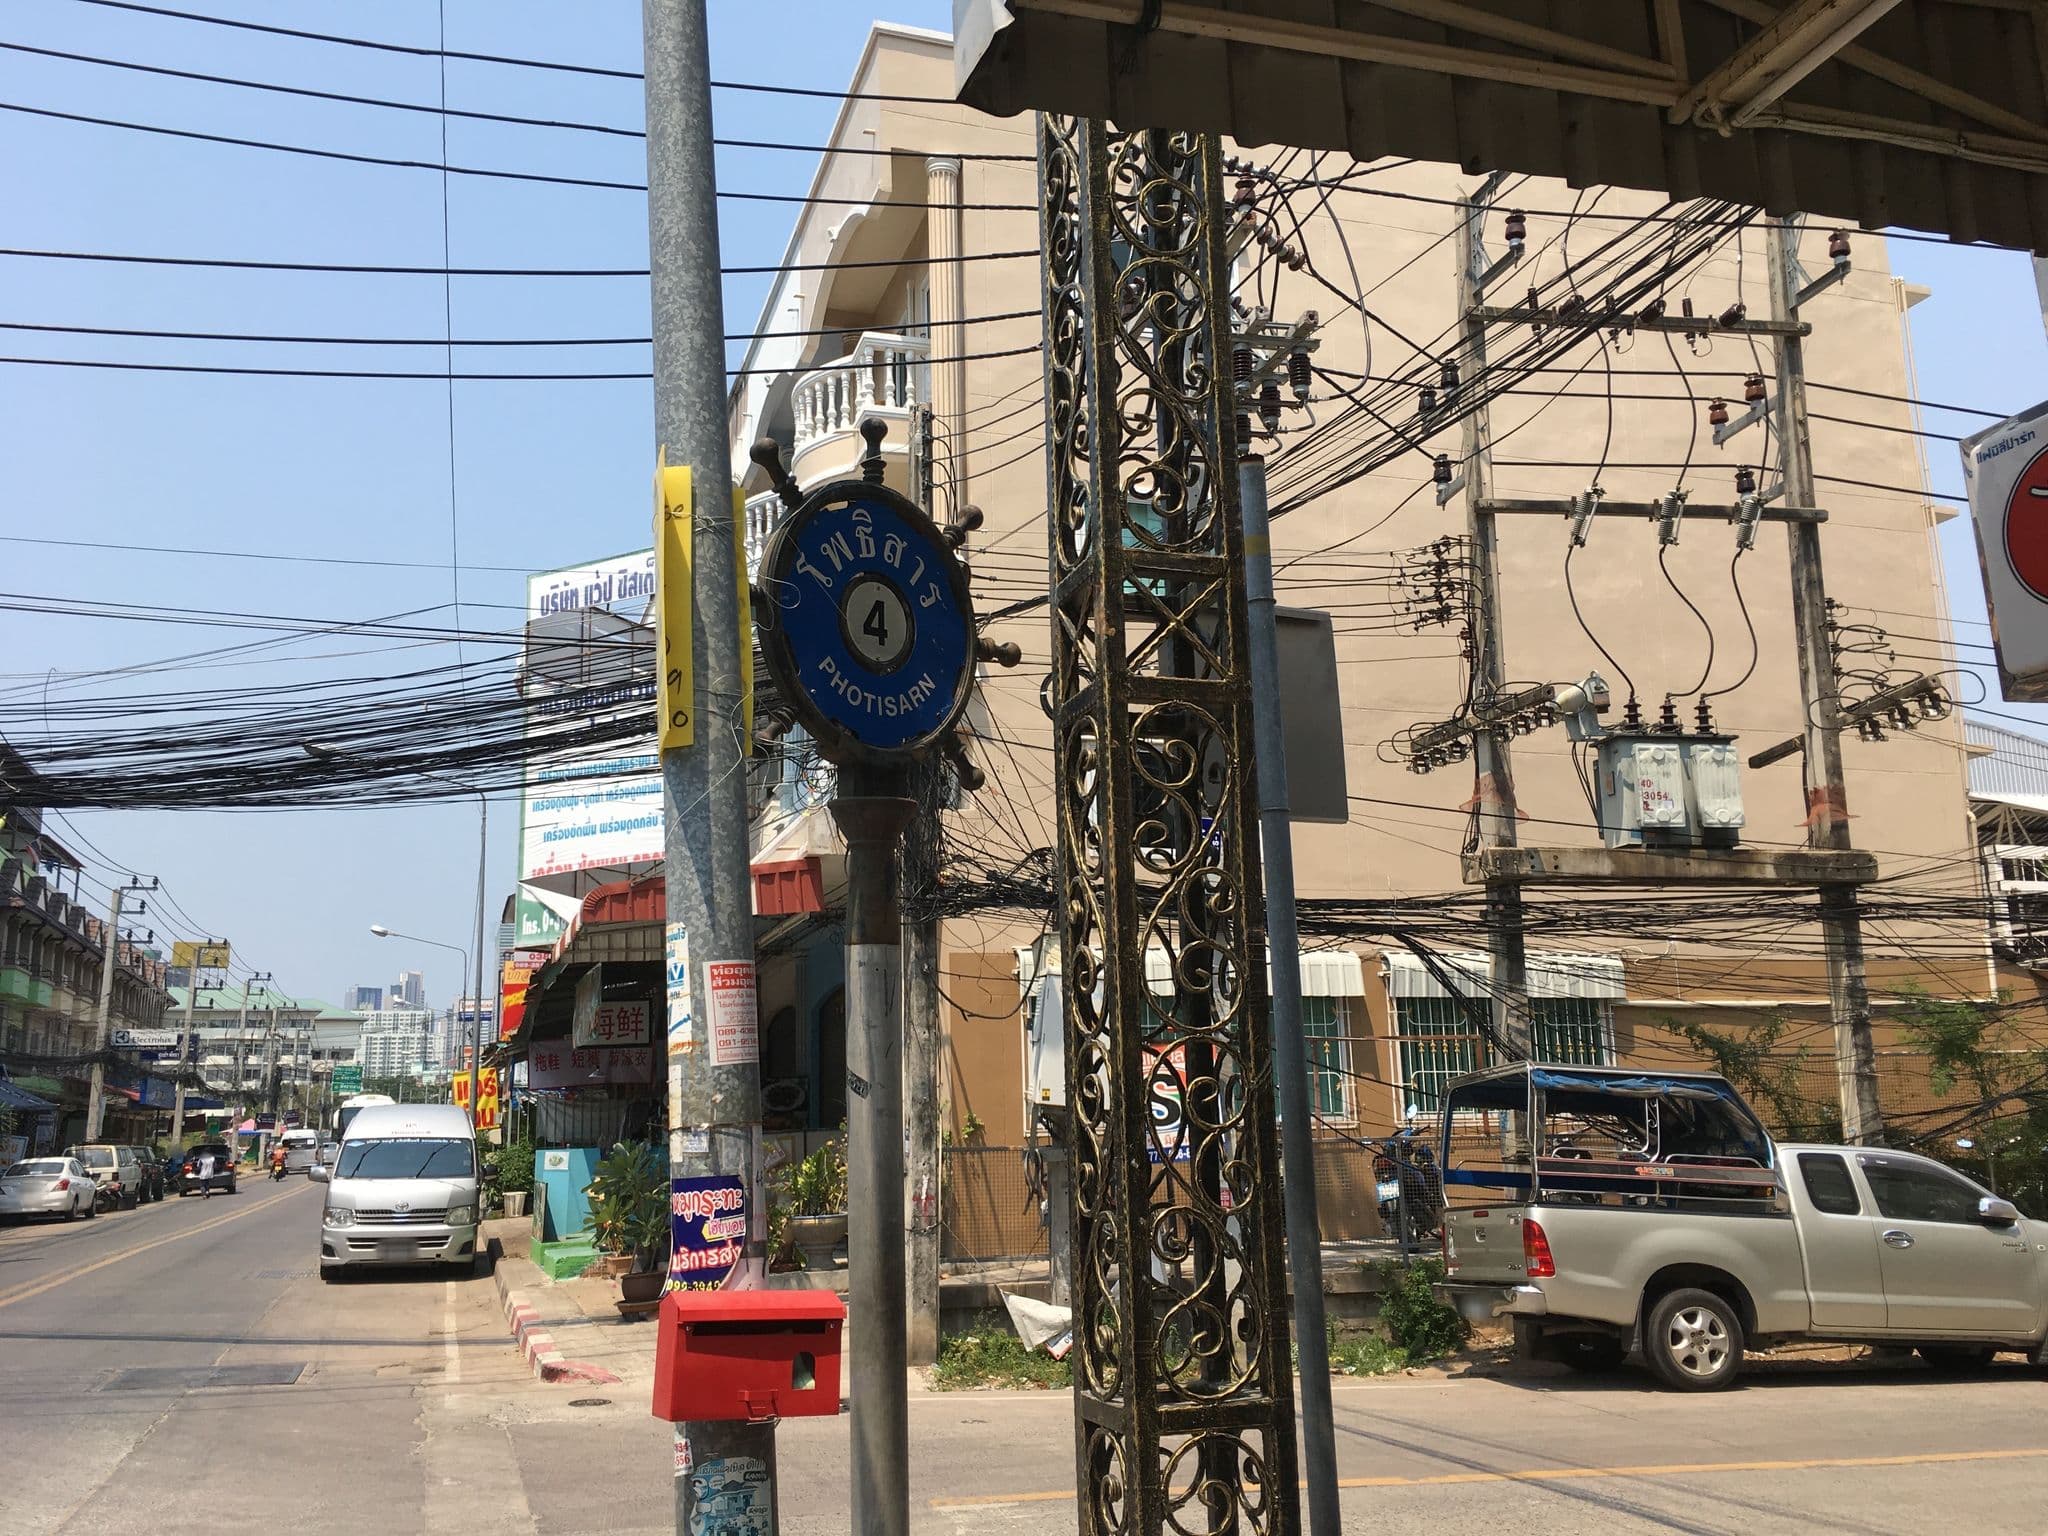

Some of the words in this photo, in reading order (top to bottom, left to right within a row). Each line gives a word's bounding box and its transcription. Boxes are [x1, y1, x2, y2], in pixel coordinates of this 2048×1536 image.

[1976, 430, 2036, 465] แฟมิลี่มาร์ท
[796, 508, 942, 608] โพธิสาร
[863, 600, 888, 647] 4
[818, 656, 936, 717] PHOTISARN
[1643, 791, 1669, 801] 3054
[132, 1035, 172, 1044] Electrolux
[672, 1188, 744, 1222] หมูกระทะ
